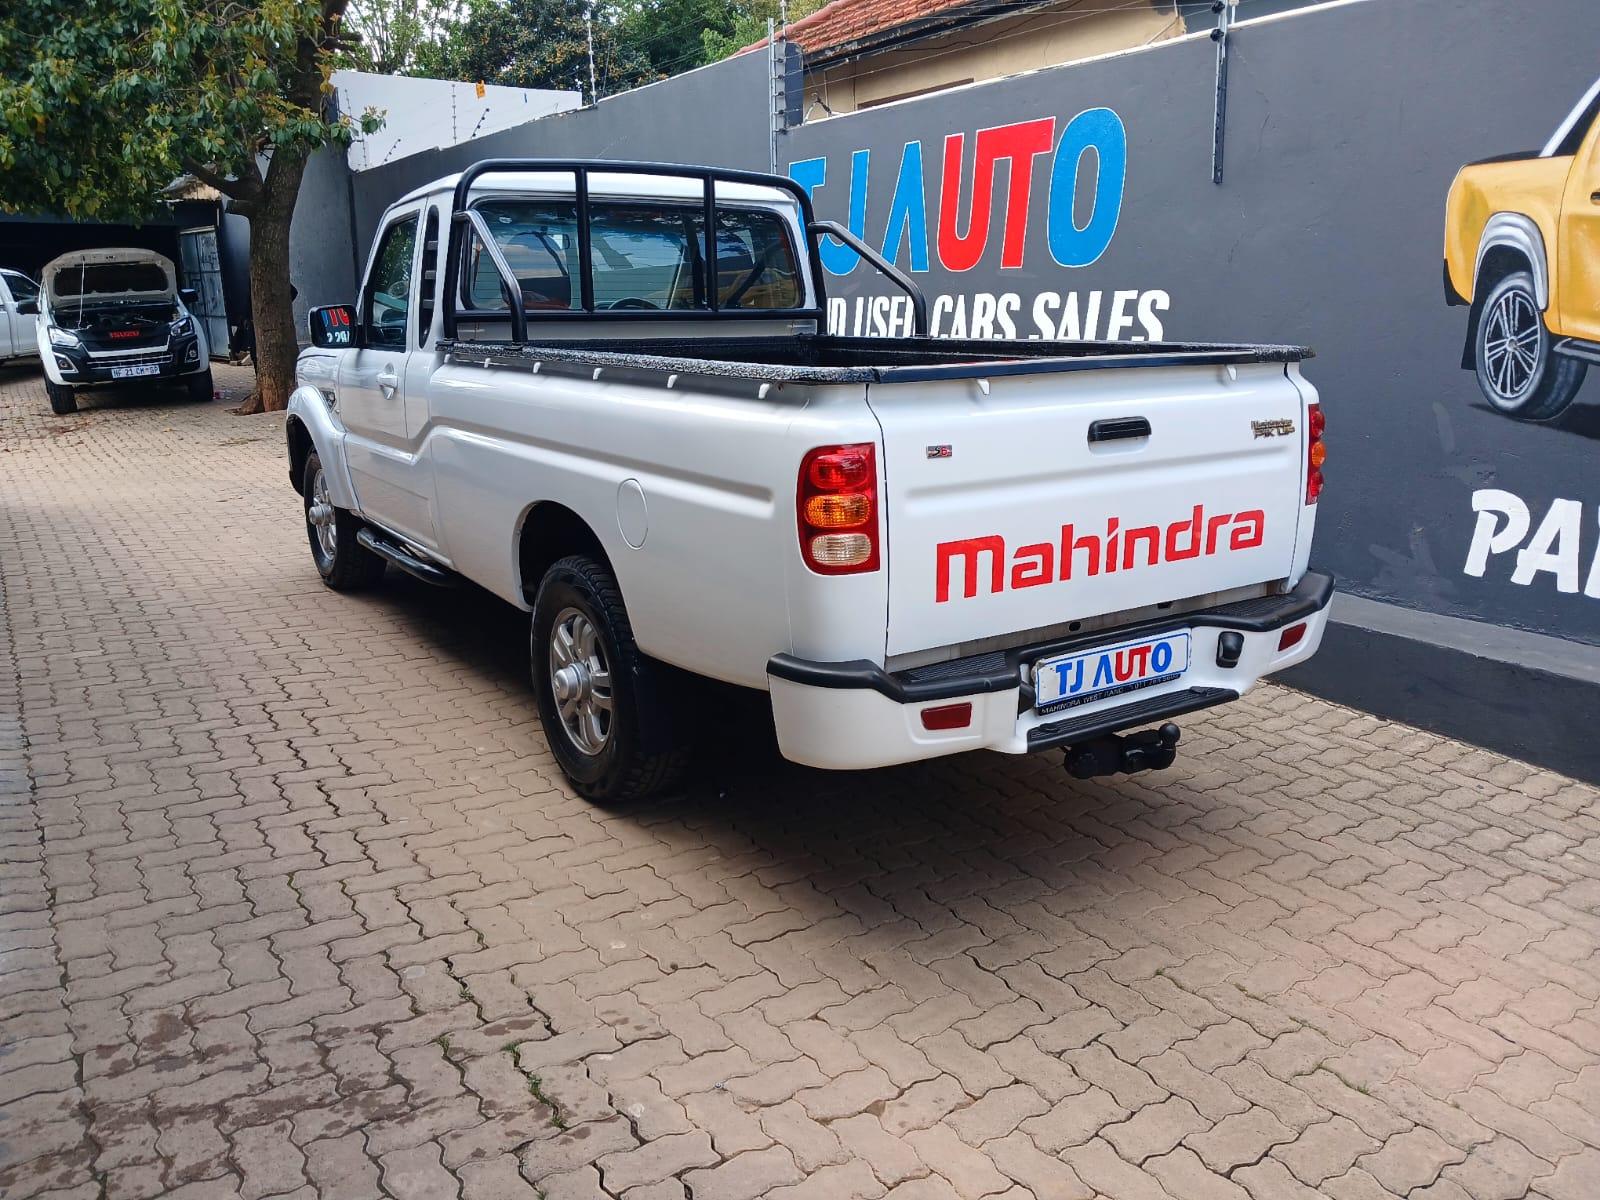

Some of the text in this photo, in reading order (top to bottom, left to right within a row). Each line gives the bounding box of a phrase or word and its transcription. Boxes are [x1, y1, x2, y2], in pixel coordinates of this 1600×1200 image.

[789, 107, 1127, 276] TJ AUTO
[930, 294, 1020, 339] CARS
[1056, 641, 1172, 695] TJ AUTO
